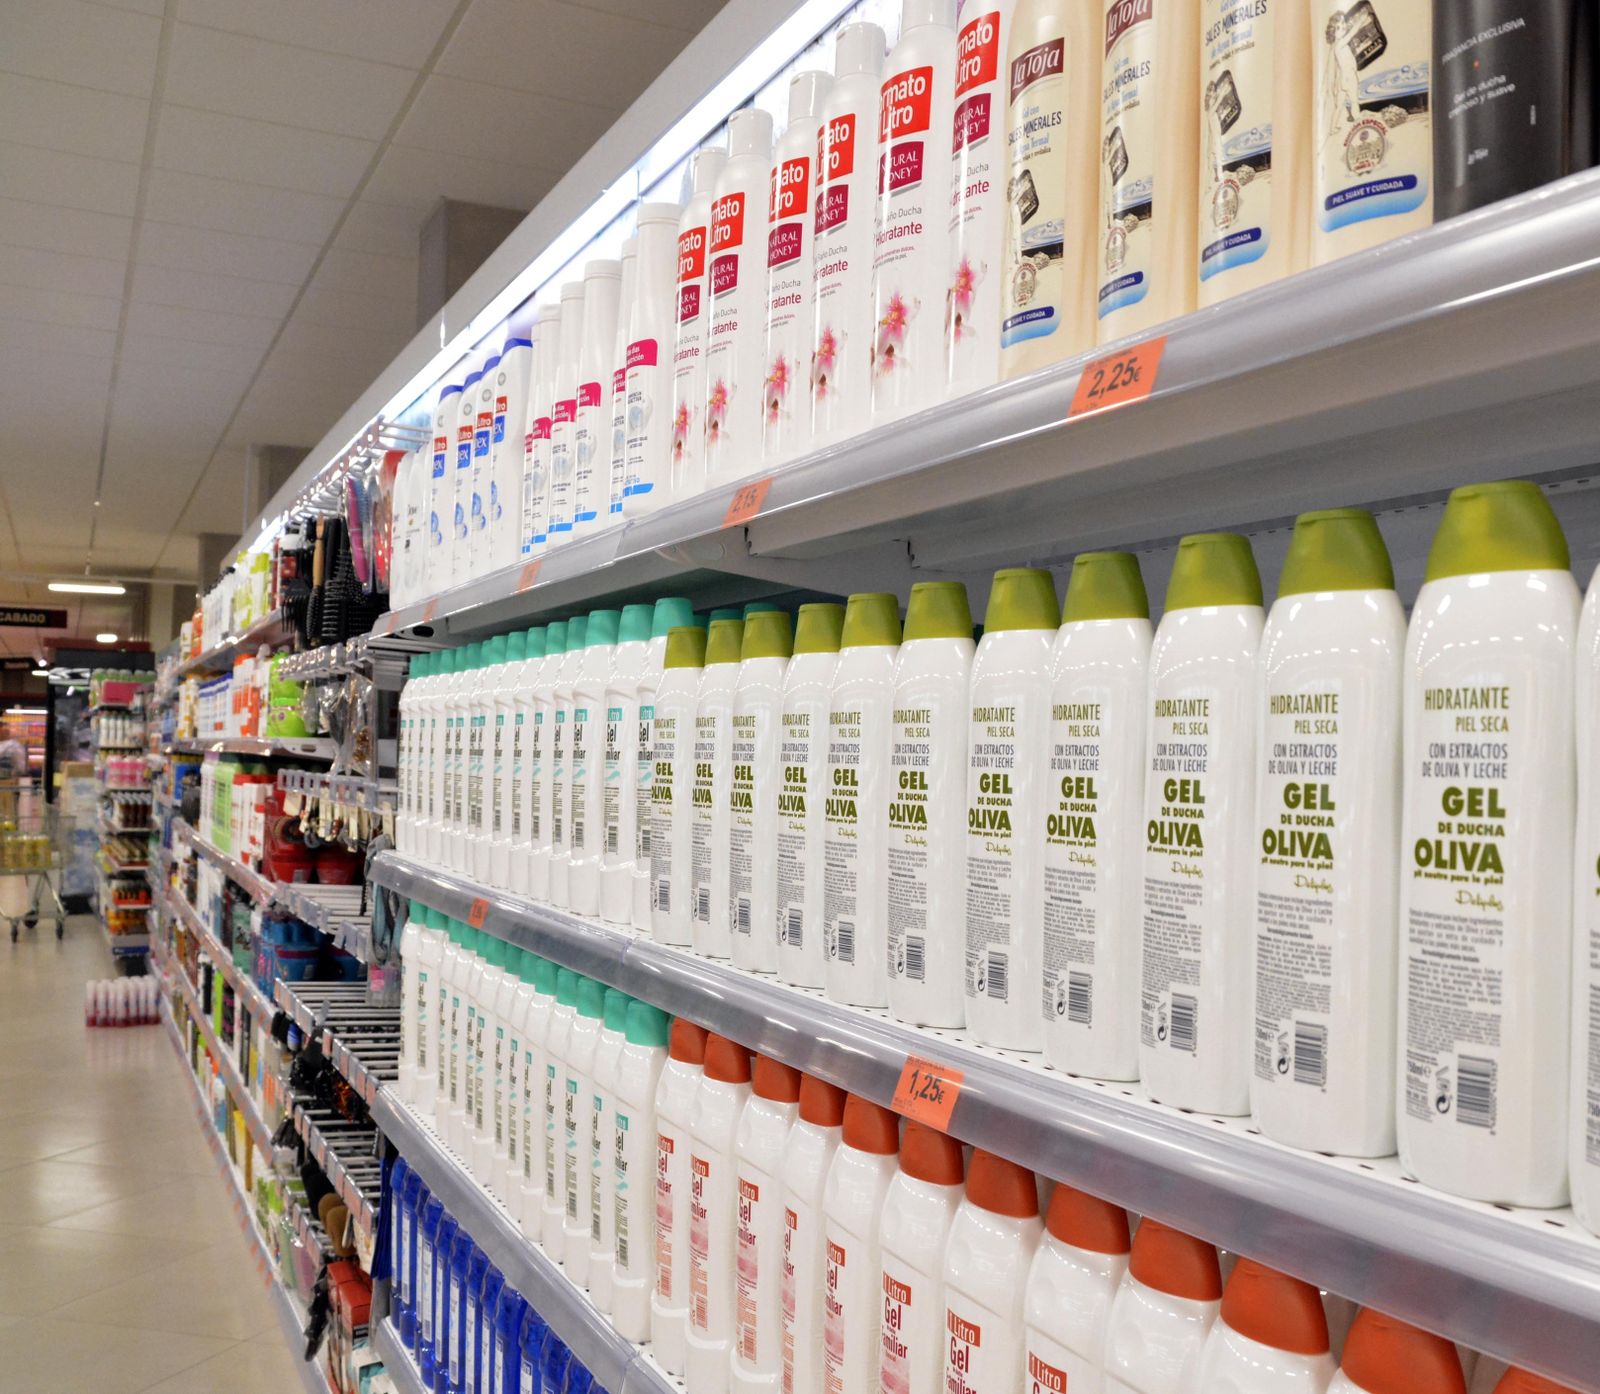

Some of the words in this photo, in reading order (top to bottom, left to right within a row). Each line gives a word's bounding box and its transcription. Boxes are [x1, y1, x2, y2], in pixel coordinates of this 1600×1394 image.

[1222, 0, 1267, 34] MINERALES
[1478, 17, 1525, 43] EXCLUSIVA
[958, 22, 993, 57] mato
[1024, 47, 1060, 77] Toja
[1115, 60, 1151, 93] MINERALES
[1478, 75, 1506, 91] ducha
[880, 74, 926, 111] rmato
[882, 105, 913, 136] Litro
[1023, 111, 1062, 138] MINERALES
[967, 163, 988, 176] Ducha
[1371, 181, 1404, 193] CUIDADA
[898, 206, 922, 219] Ducha
[1087, 357, 1142, 399] 2,25€
[1270, 694, 1338, 714] HIDRATANTE
[1425, 687, 1509, 710] HIDRATANTE
[973, 707, 1015, 722] HIDRATANTE
[1052, 704, 1101, 721] HIDRATANTE
[1155, 699, 1209, 717] HIDRATANTE
[893, 709, 931, 724] HIDRATANTE
[1456, 716, 1476, 732] PIEL
[1481, 716, 1509, 732] SECA
[916, 727, 930, 738] SECA
[987, 726, 998, 737] PIEL
[1000, 726, 1014, 737] SECA
[1069, 725, 1081, 737] PIEL
[1083, 725, 1100, 737] SECA
[1173, 722, 1187, 735] PIEL
[1189, 722, 1208, 735] SECA
[1295, 720, 1311, 733] PIEL
[1315, 720, 1338, 734] SECA
[983, 744, 1014, 755] EXTRACTOS
[1055, 744, 1063, 756] CON
[1065, 744, 1100, 757] EXTRACTOS
[1157, 743, 1167, 756] CON
[1168, 743, 1207, 757] EXTRACTOS
[1274, 744, 1287, 757] CON
[1289, 744, 1337, 758] EXTRACTOS
[1429, 743, 1446, 758] CON
[1450, 743, 1508, 759] EXTRACTOS
[656, 762, 673, 776] GEL
[913, 756, 929, 766] LECHE
[995, 757, 1014, 768] LECHE
[1072, 758, 1077, 770] Y
[1079, 758, 1099, 771] LECHE
[1160, 758, 1176, 771] OLIVA
[1177, 759, 1183, 772] Y
[1184, 759, 1207, 772] LECHE
[1269, 760, 1276, 773] DE
[1278, 761, 1298, 774] OLIVA
[1301, 761, 1307, 775] Y
[1309, 761, 1336, 775] LECHE
[697, 763, 713, 778] GEL
[734, 765, 754, 781] GEL
[785, 766, 807, 783] GEL
[834, 768, 859, 786] GEL
[1422, 761, 1432, 777] DE
[1434, 762, 1460, 778] OLIVA
[1464, 762, 1470, 778] Y
[1474, 762, 1507, 779] LECHE
[899, 770, 928, 790] GEL
[980, 773, 1012, 794] GEL
[1061, 776, 1097, 799] GEL
[790, 785, 806, 793] DUCHA
[839, 789, 858, 797] DUCHA
[906, 793, 928, 801] DUCHA
[1164, 778, 1205, 804] GEL
[1284, 782, 1335, 811] GEL
[825, 798, 858, 818] OLIVA
[978, 797, 985, 805] DE
[987, 797, 1012, 806] DUCHA
[1060, 802, 1068, 811] DE
[1070, 802, 1097, 812] DUCHA
[1442, 786, 1506, 818] GEL
[889, 803, 927, 824] OLIVA
[968, 808, 1011, 830] OLIVA
[1161, 806, 1171, 817] DE
[1173, 807, 1205, 819] DUCHA
[1281, 814, 1292, 825] DE
[1296, 814, 1335, 827] DUCHA
[1047, 814, 1096, 839] OLIVA
[1148, 820, 1203, 848] OLIVA
[1438, 822, 1452, 834] DE
[1457, 823, 1505, 837] DUCHA
[1262, 828, 1333, 860] OLIVA
[1189, 849, 1203, 857] piel
[1414, 838, 1504, 873] OLIVA
[1317, 860, 1333, 870] piel
[1484, 875, 1503, 886] piel
[909, 1069, 945, 1104] 1,25€
[888, 1278, 907, 1303] Litro
[885, 1296, 902, 1331] Gel
[954, 1315, 975, 1344] Litro
[950, 1336, 969, 1374] Gel
[1036, 1360, 1060, 1391] Litro
